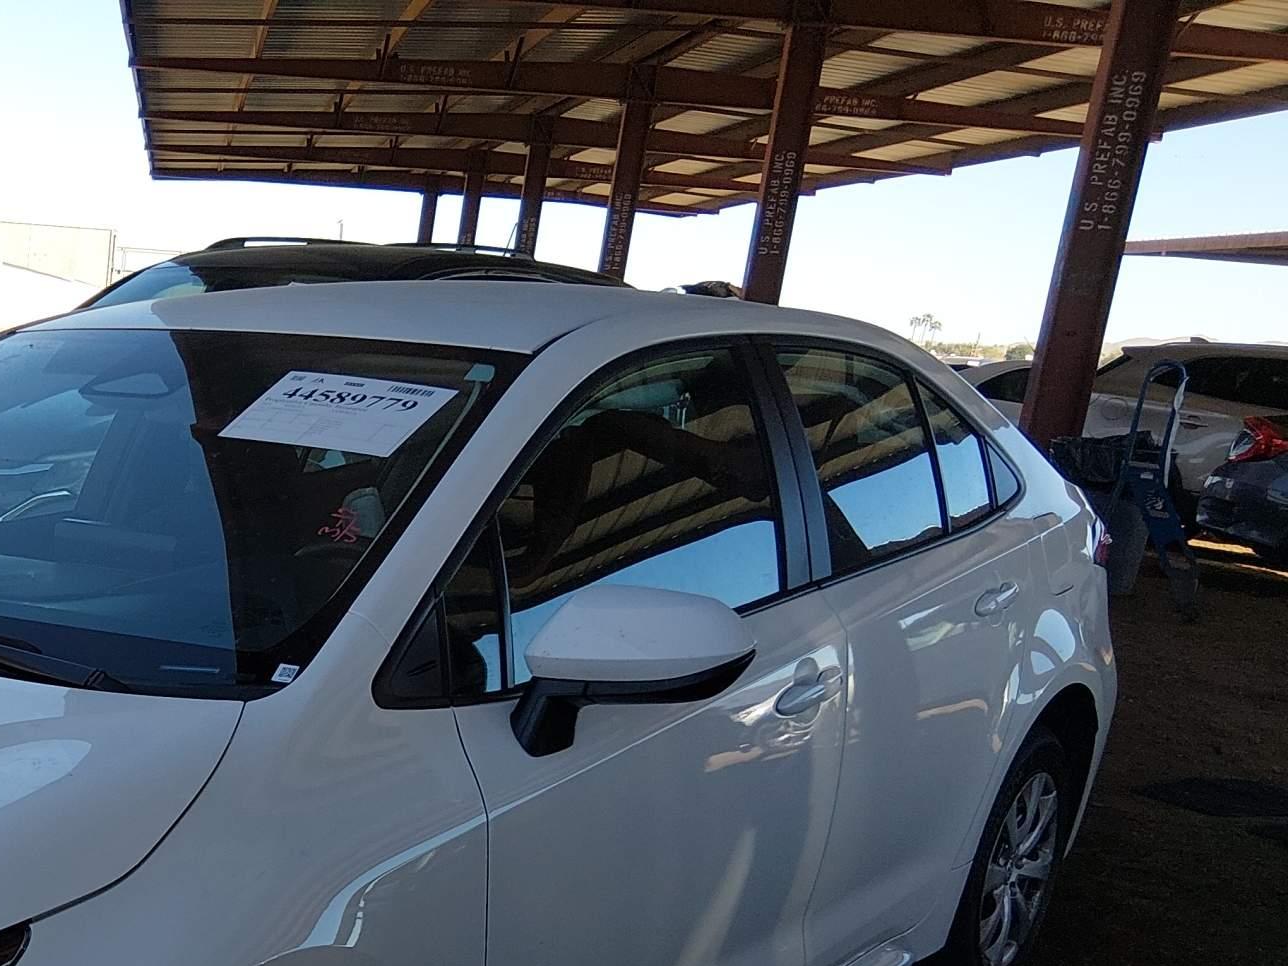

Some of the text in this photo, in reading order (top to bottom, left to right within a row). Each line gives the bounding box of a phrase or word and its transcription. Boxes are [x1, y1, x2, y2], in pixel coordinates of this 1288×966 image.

[1090, 114, 1119, 186] PREFAB
[1109, 70, 1130, 104] INC.
[1097, 71, 1147, 231] 1-866-799-0969
[765, 179, 780, 226] PREFAB
[282, 385, 419, 412] 44589779
